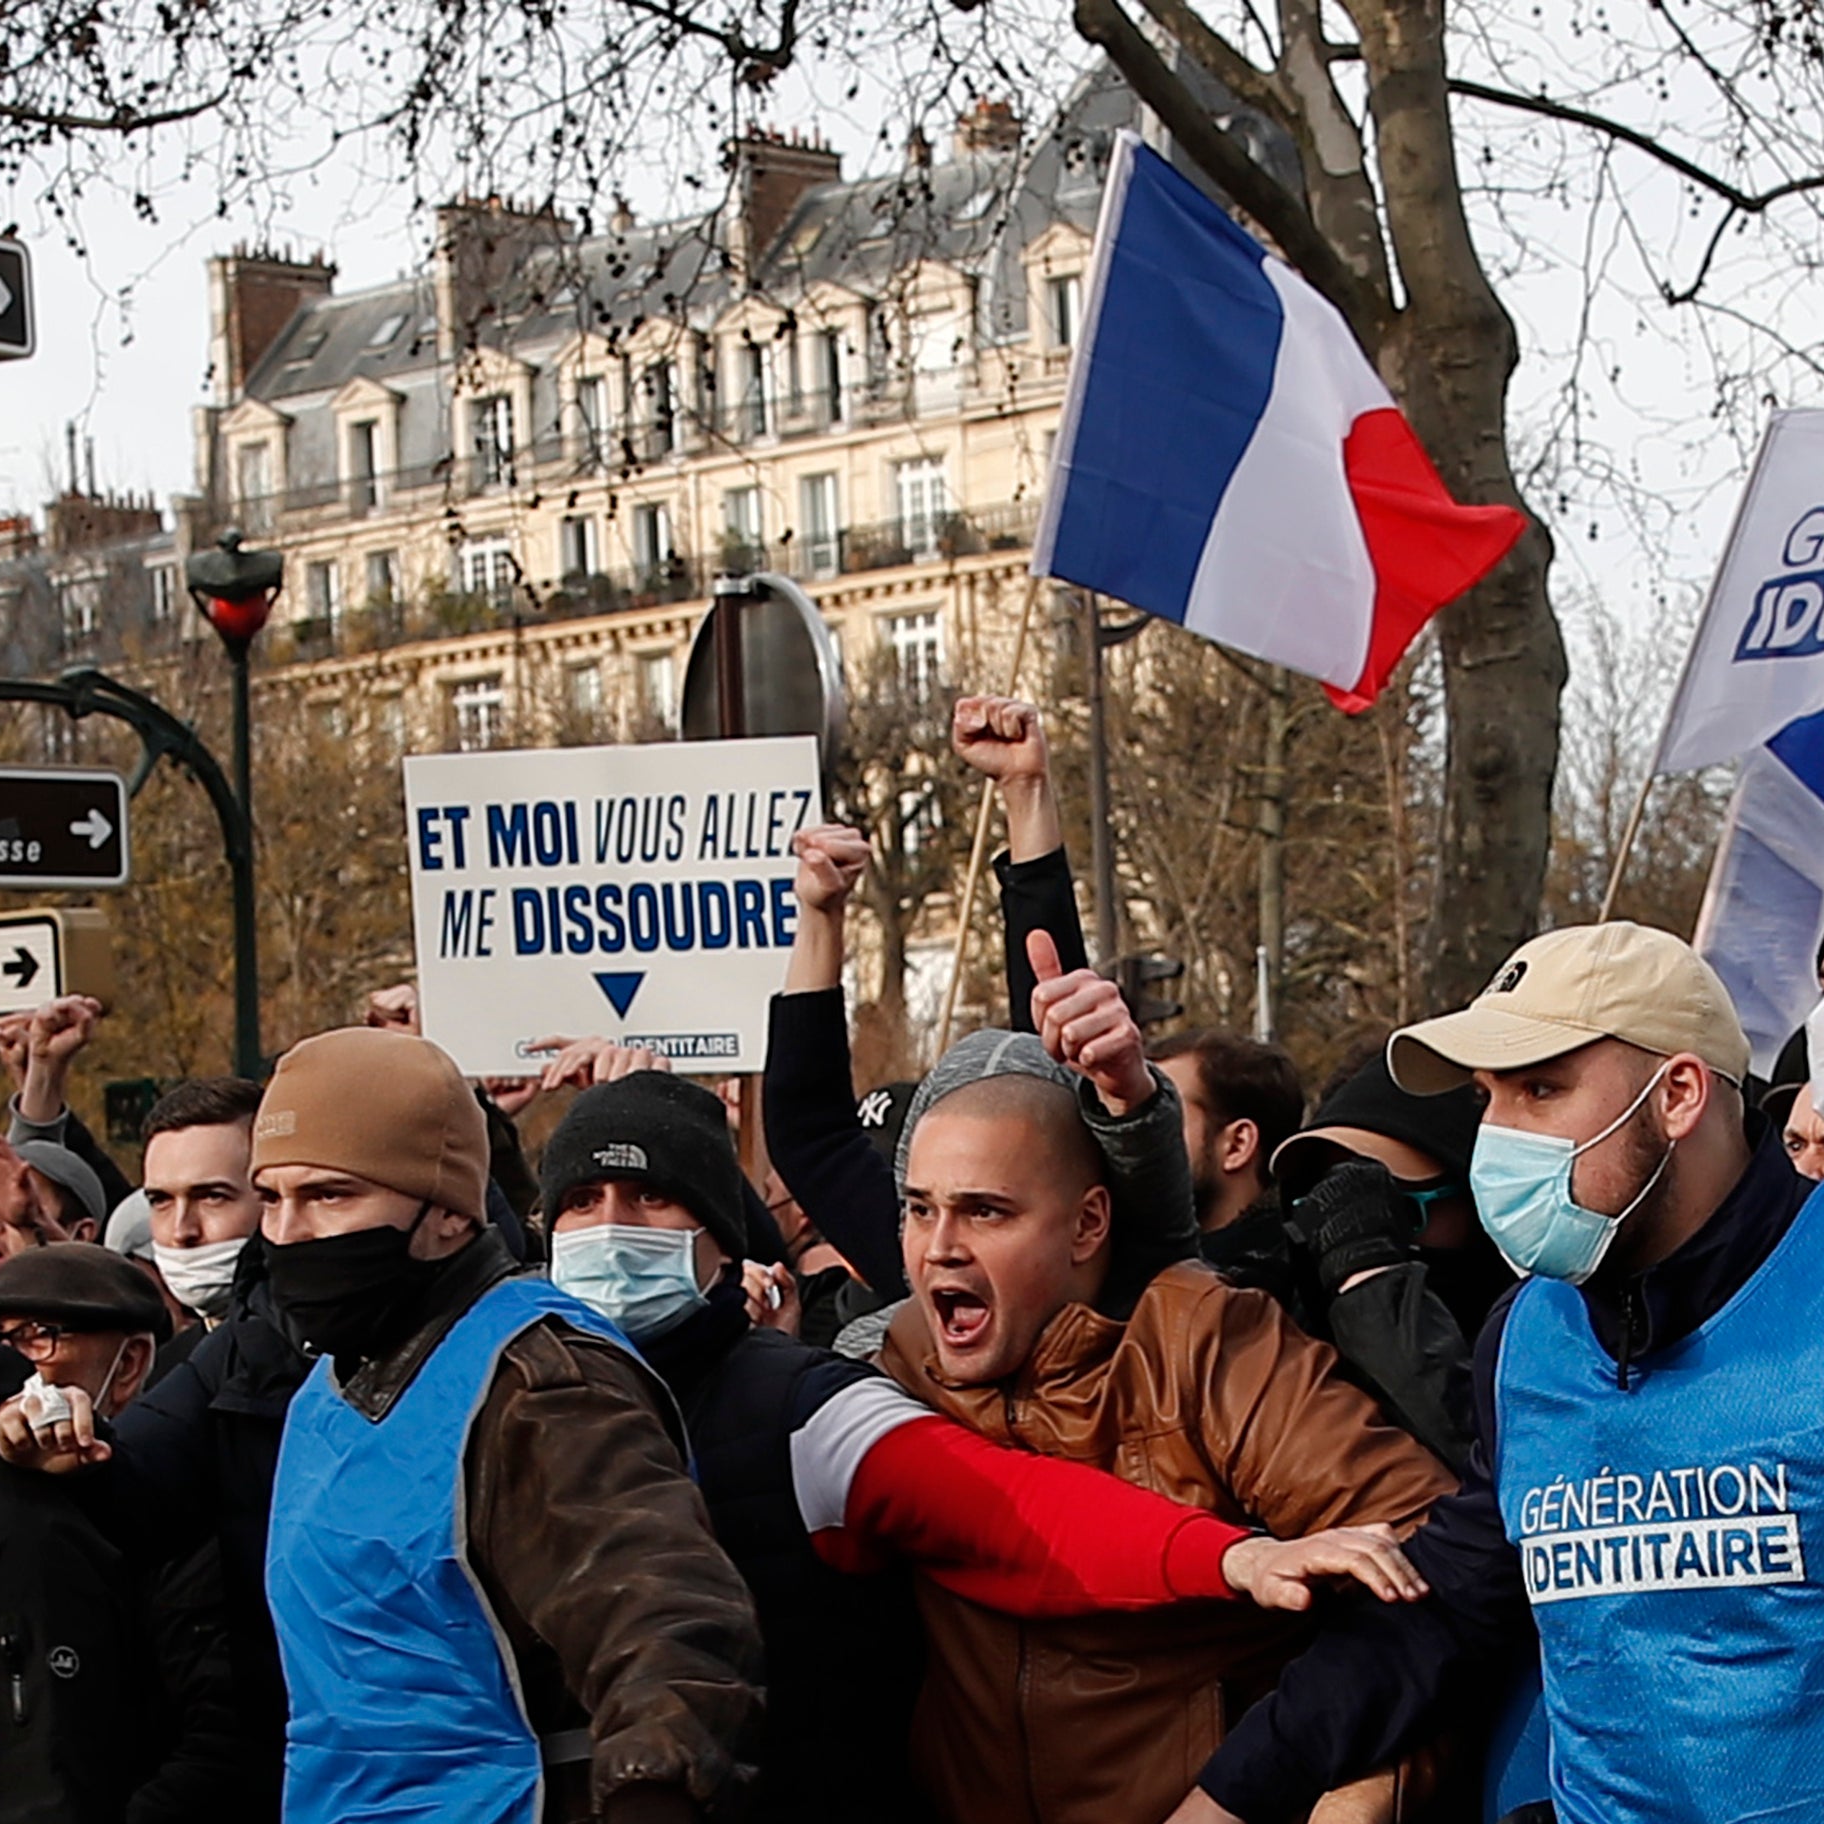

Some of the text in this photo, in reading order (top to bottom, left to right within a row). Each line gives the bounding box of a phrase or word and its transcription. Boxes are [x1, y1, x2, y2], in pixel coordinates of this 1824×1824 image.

[417, 789, 814, 872] ET MOI VOUS ALLEZ
[438, 878, 799, 959] ME DISSOUDRE
[1520, 1463, 1788, 1535] GÉNÉRATION
[1526, 1525, 1794, 1595] IDENTITAIRE
